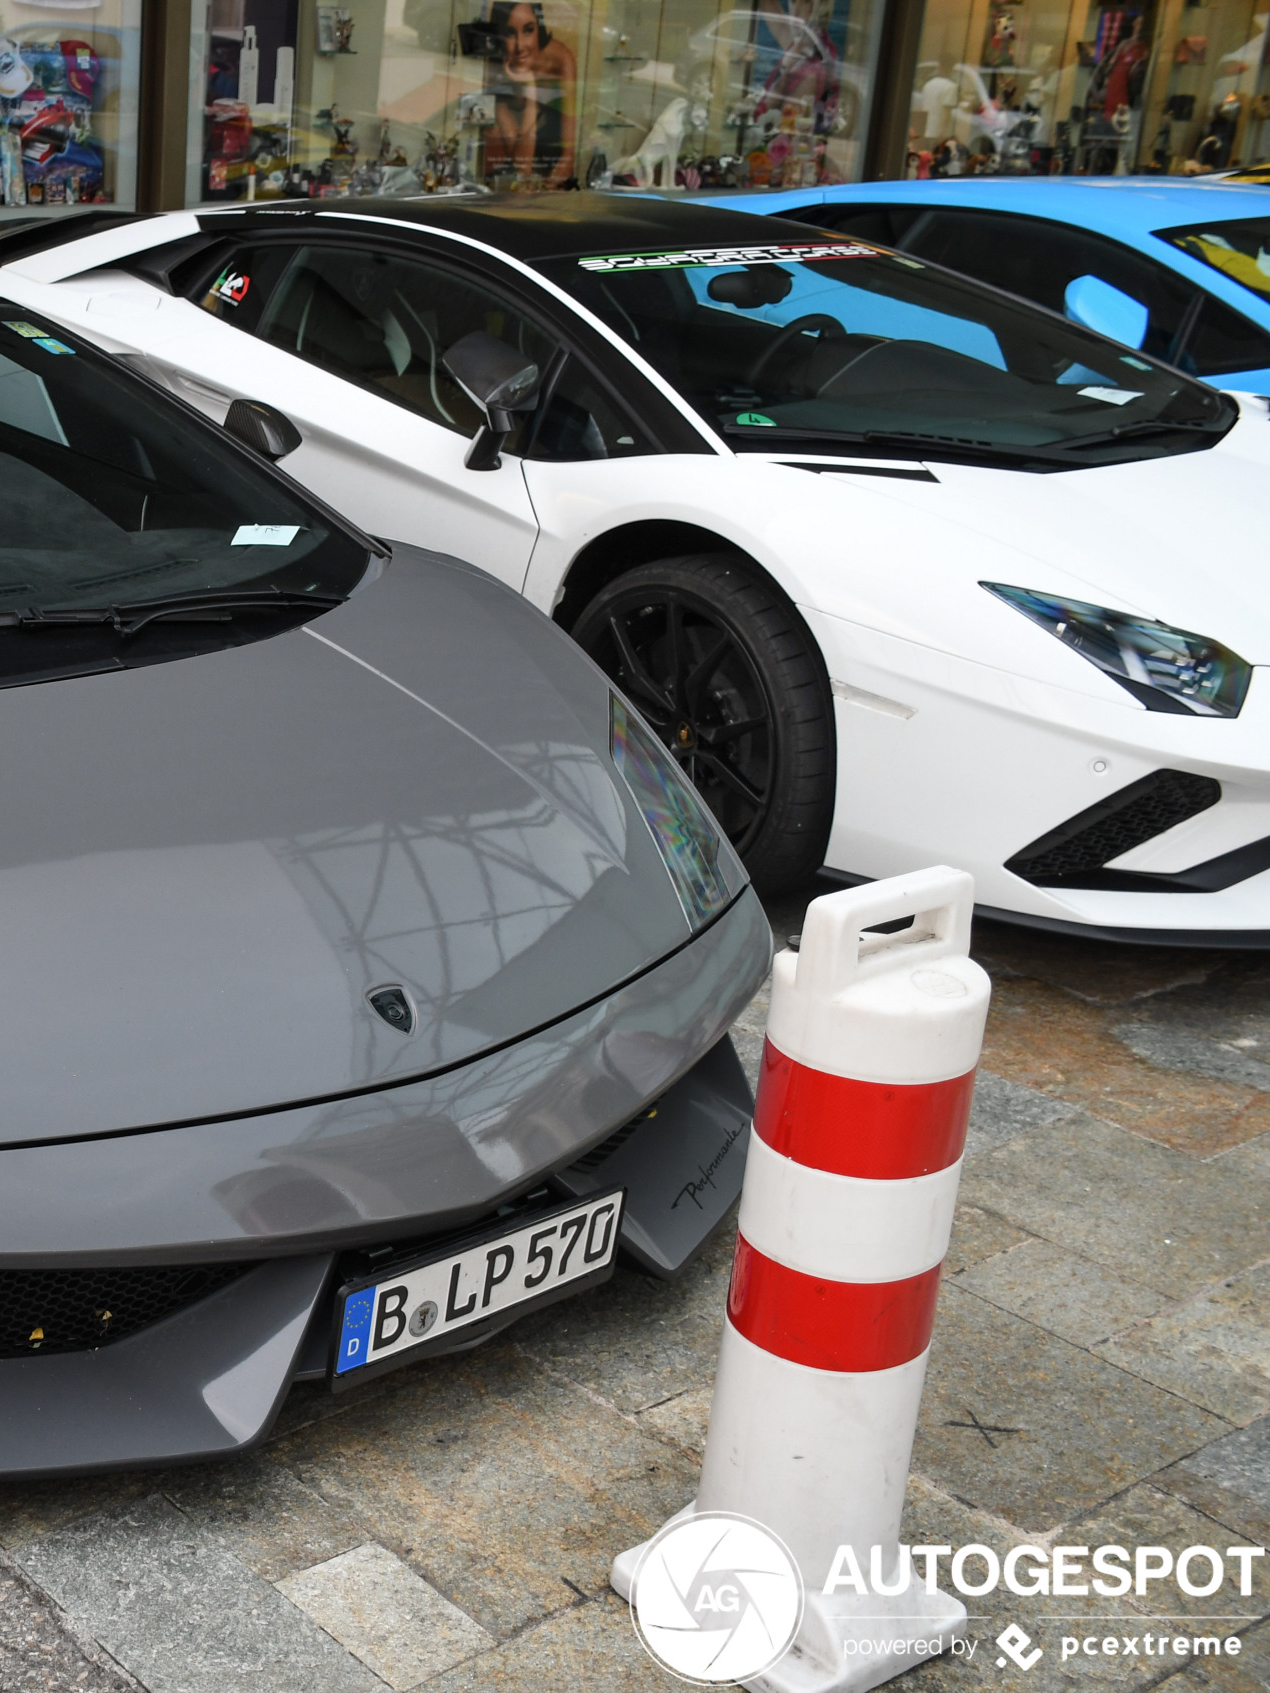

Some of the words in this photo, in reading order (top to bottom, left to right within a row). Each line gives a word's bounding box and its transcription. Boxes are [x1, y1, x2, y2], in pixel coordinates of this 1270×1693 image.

[670, 1122, 746, 1210] Performante
[346, 1338, 361, 1357] D
[372, 1285, 409, 1352] B
